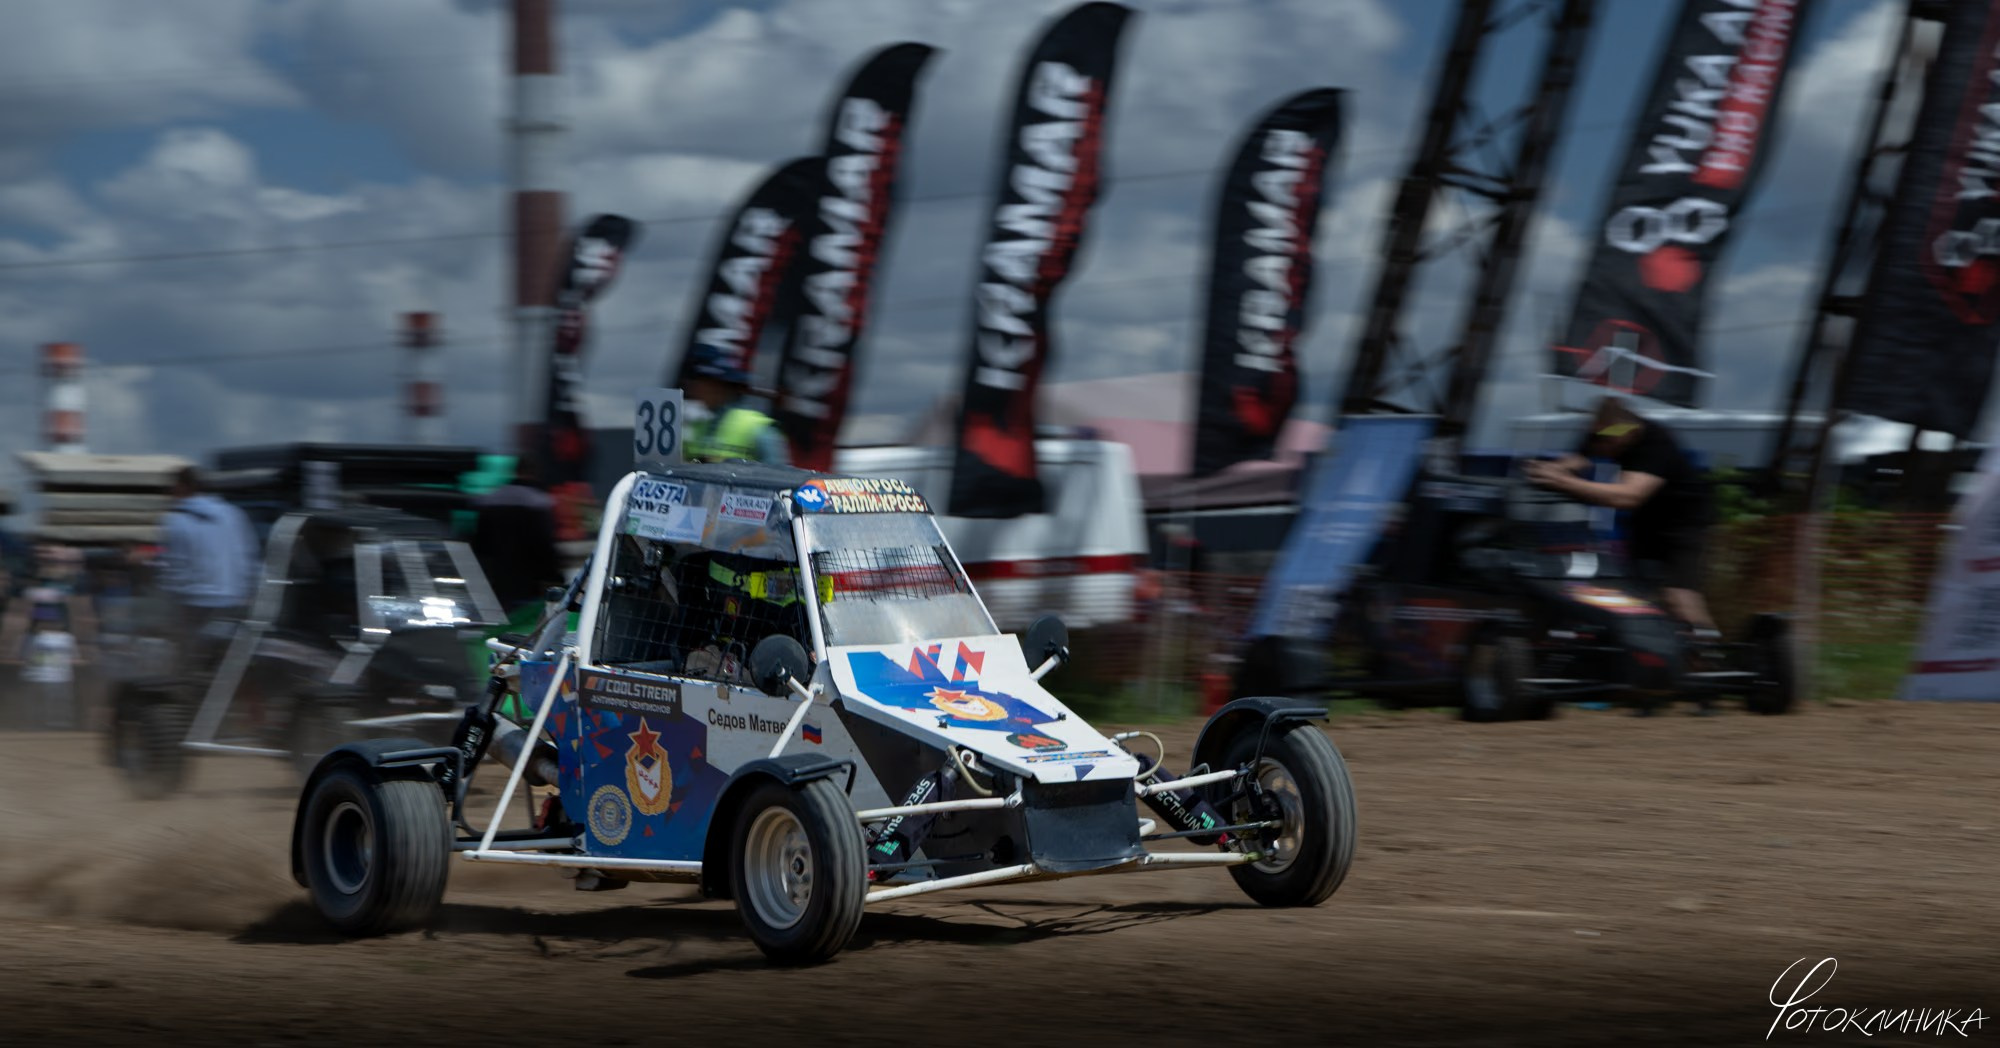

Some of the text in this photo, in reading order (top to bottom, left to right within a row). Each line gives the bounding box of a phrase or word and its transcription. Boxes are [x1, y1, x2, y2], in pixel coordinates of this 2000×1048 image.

[1638, 0, 1766, 173] YUKA A
[1729, 0, 1798, 104] RACIN
[783, 96, 891, 417] KRAMAR
[975, 61, 1091, 391] KRAMAR
[1233, 129, 1317, 372] KRAMAR
[635, 400, 676, 456] 38
[637, 481, 687, 503] RUSTA
[605, 679, 677, 703] COOLSTREAM
[707, 707, 746, 731] Седов
[1146, 778, 1202, 832] SECTRUM
